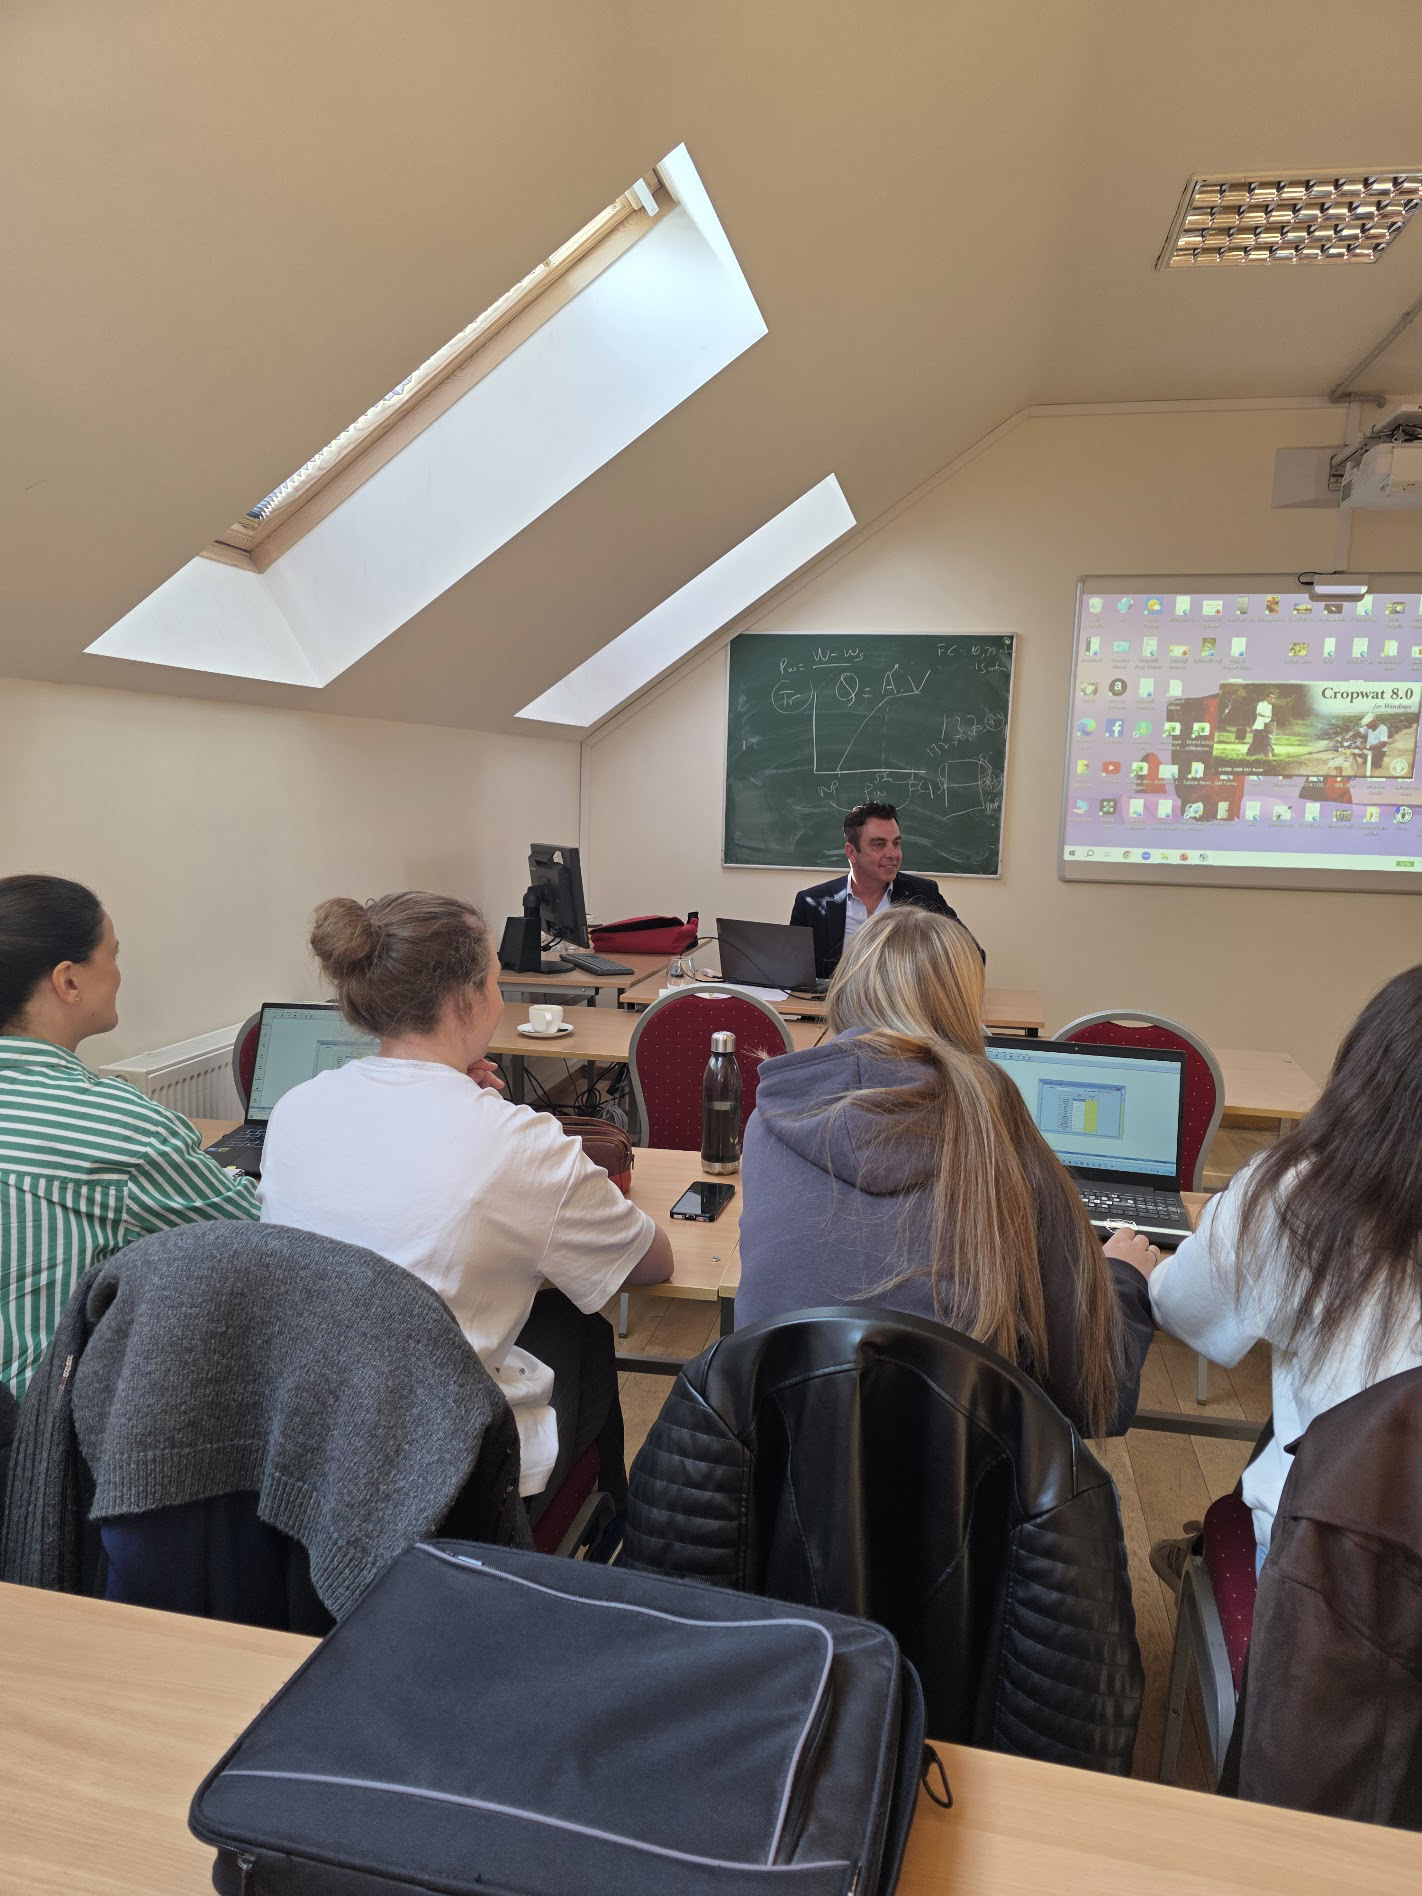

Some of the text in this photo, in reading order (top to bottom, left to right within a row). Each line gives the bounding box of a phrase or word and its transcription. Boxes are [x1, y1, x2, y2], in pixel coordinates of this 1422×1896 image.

[1321, 686, 1414, 704] Cropwat 8.0
[1372, 702, 1412, 711] for Windows
